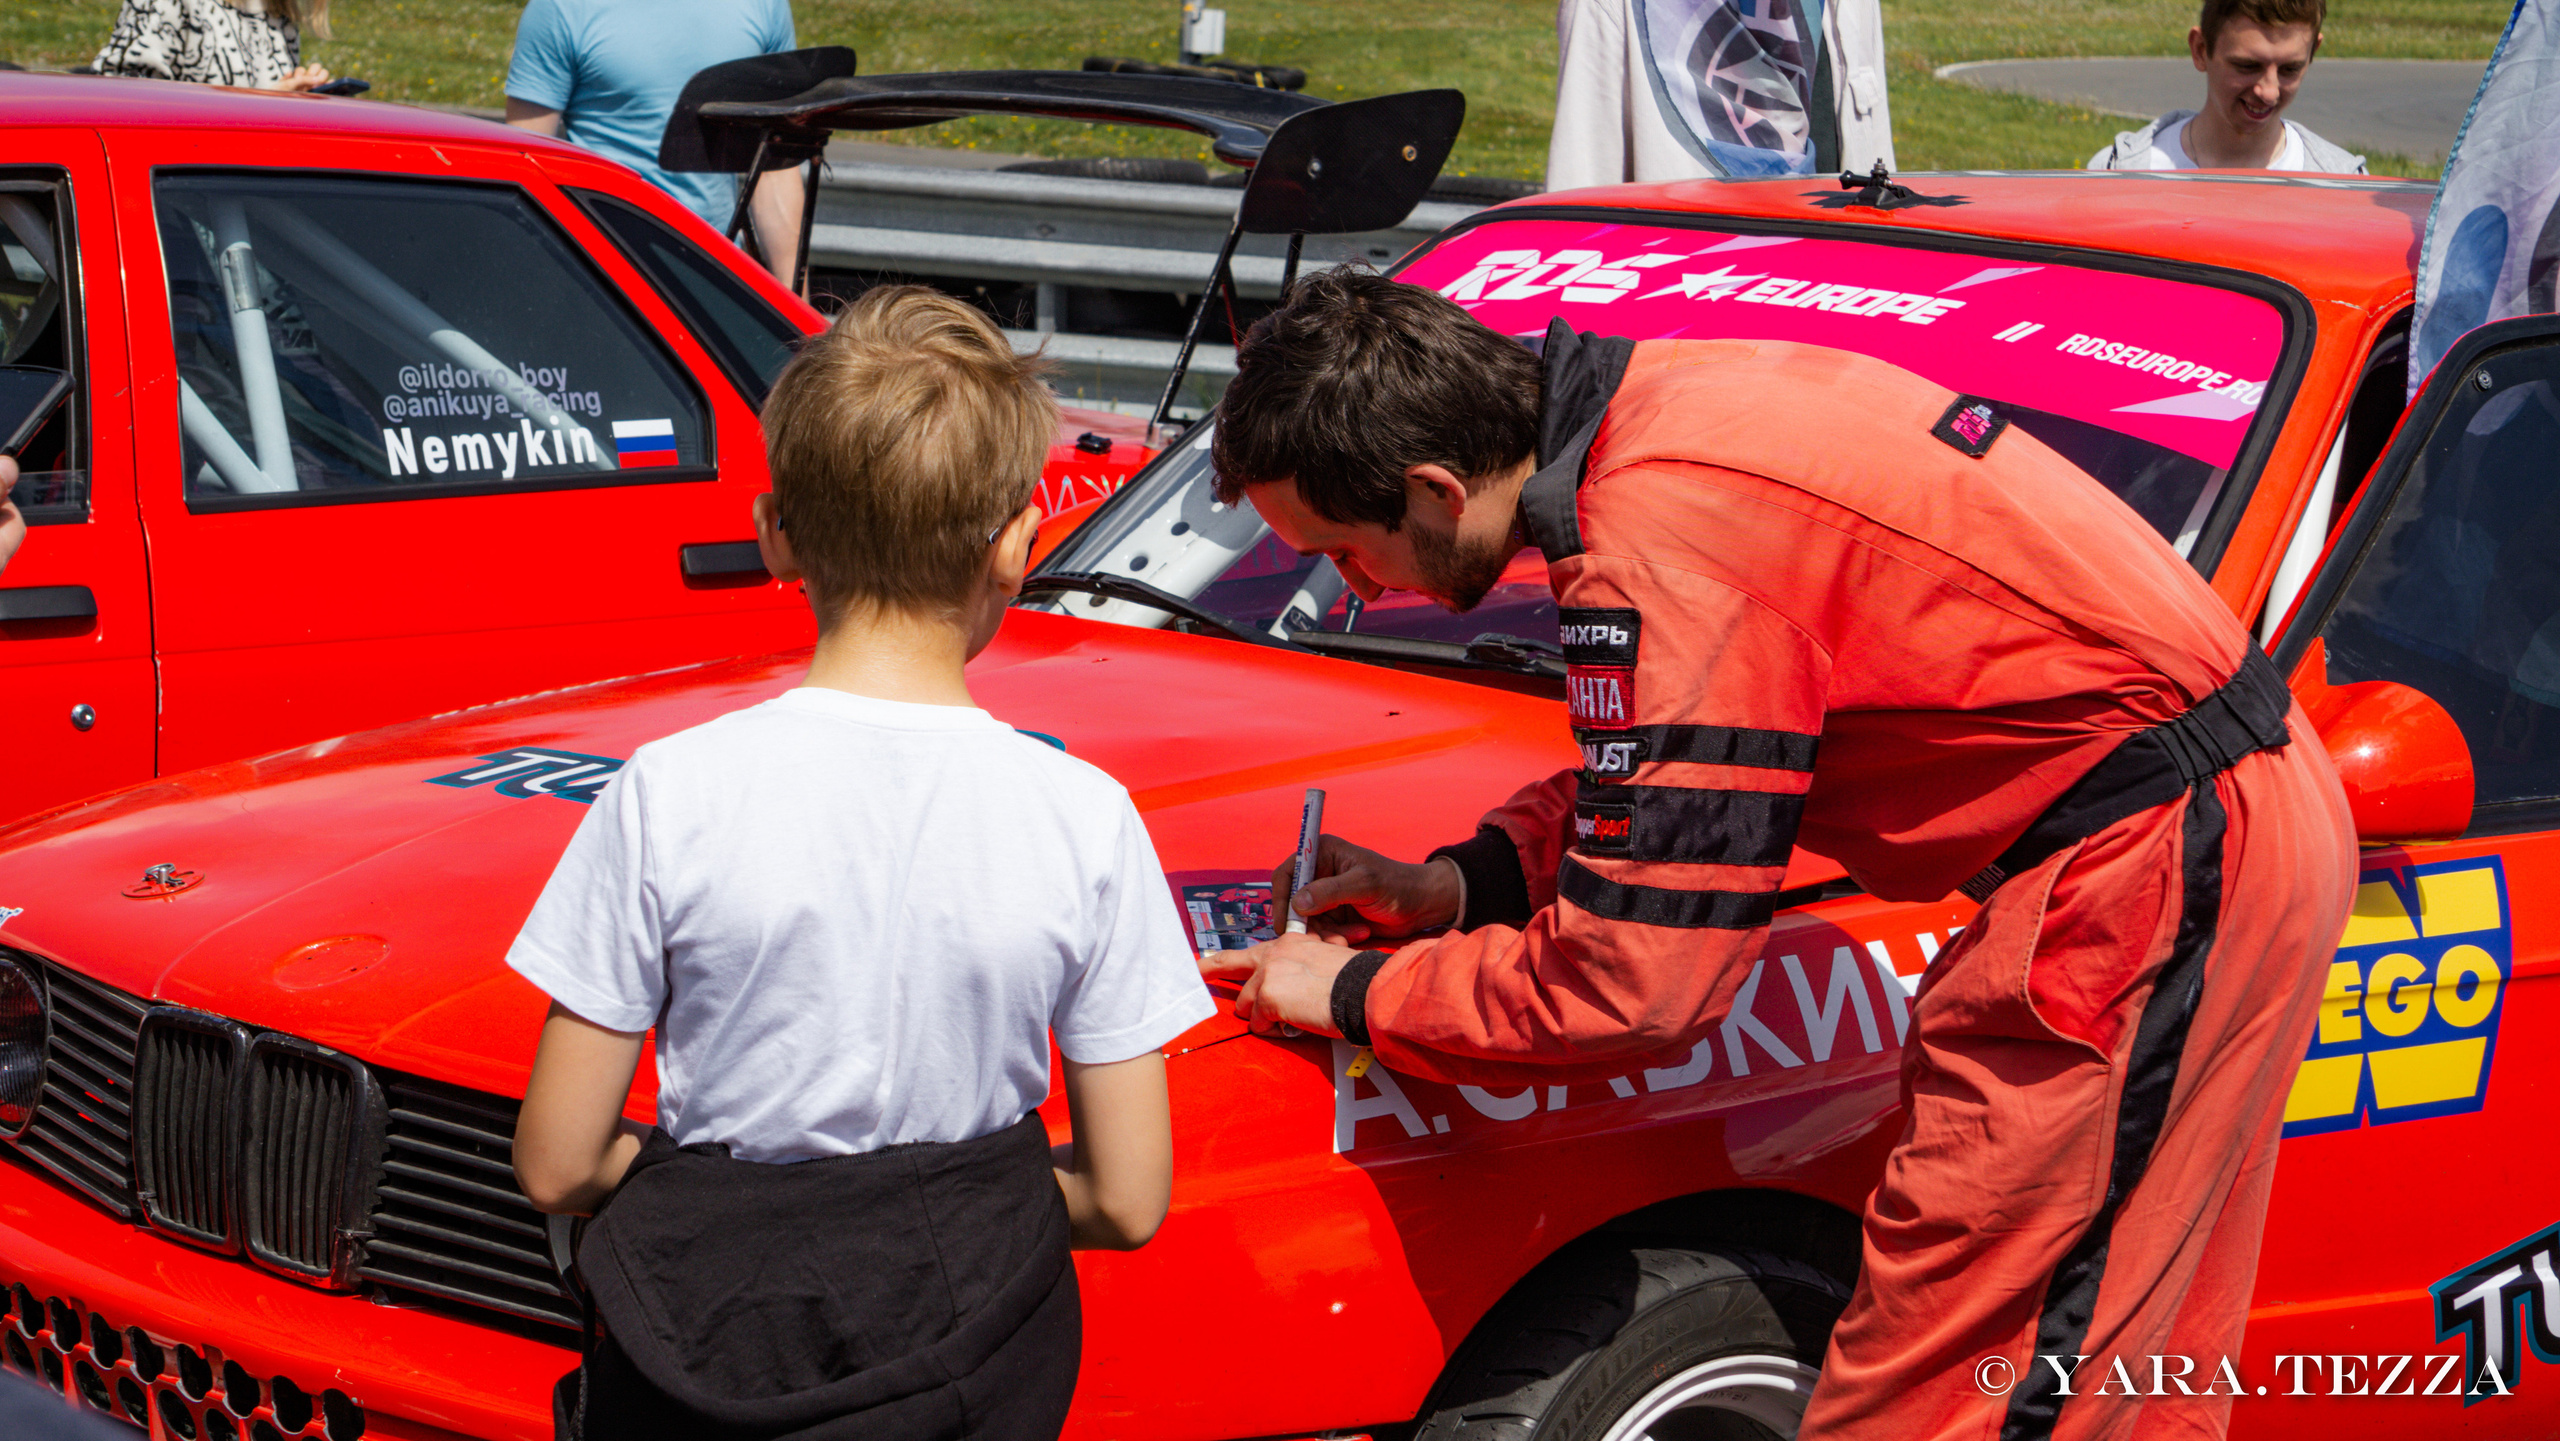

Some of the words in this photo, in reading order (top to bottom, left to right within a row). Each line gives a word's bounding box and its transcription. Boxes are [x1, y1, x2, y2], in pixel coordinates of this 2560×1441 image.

[1438, 249, 1690, 304] RDS
[1734, 277, 1967, 325] EUROPE
[2056, 333, 2264, 405] RDSEUROPE.RU
[399, 362, 567, 393] @ildorro_boy
[383, 390, 602, 423] @anikuya_racing
[383, 415, 598, 479] Nemykin
[460, 752, 618, 797] TU
